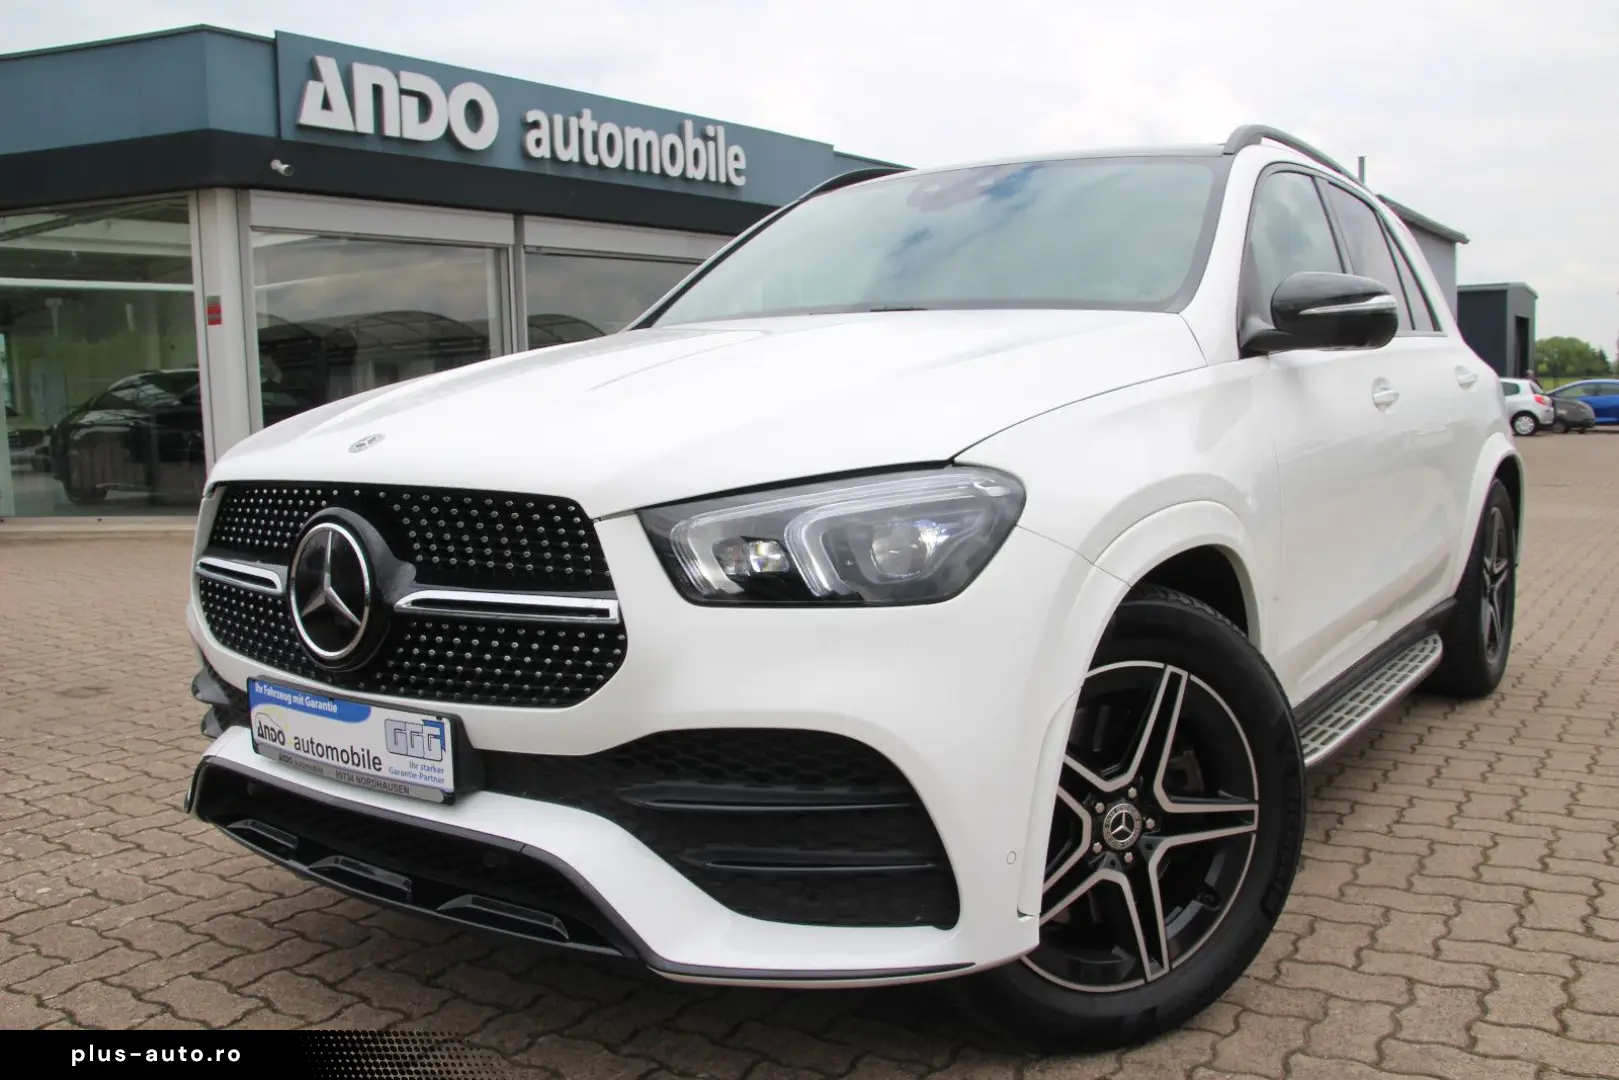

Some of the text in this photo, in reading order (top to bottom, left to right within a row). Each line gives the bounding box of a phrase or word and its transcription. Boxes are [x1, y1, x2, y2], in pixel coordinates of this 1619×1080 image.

[297, 55, 747, 187] ANDO automobile
[254, 681, 338, 713] Ihr Fahrzeug mit Garantie
[293, 735, 383, 773] automobile
[409, 760, 419, 770] Ihr
[355, 775, 410, 796] NORDHAUSEN
